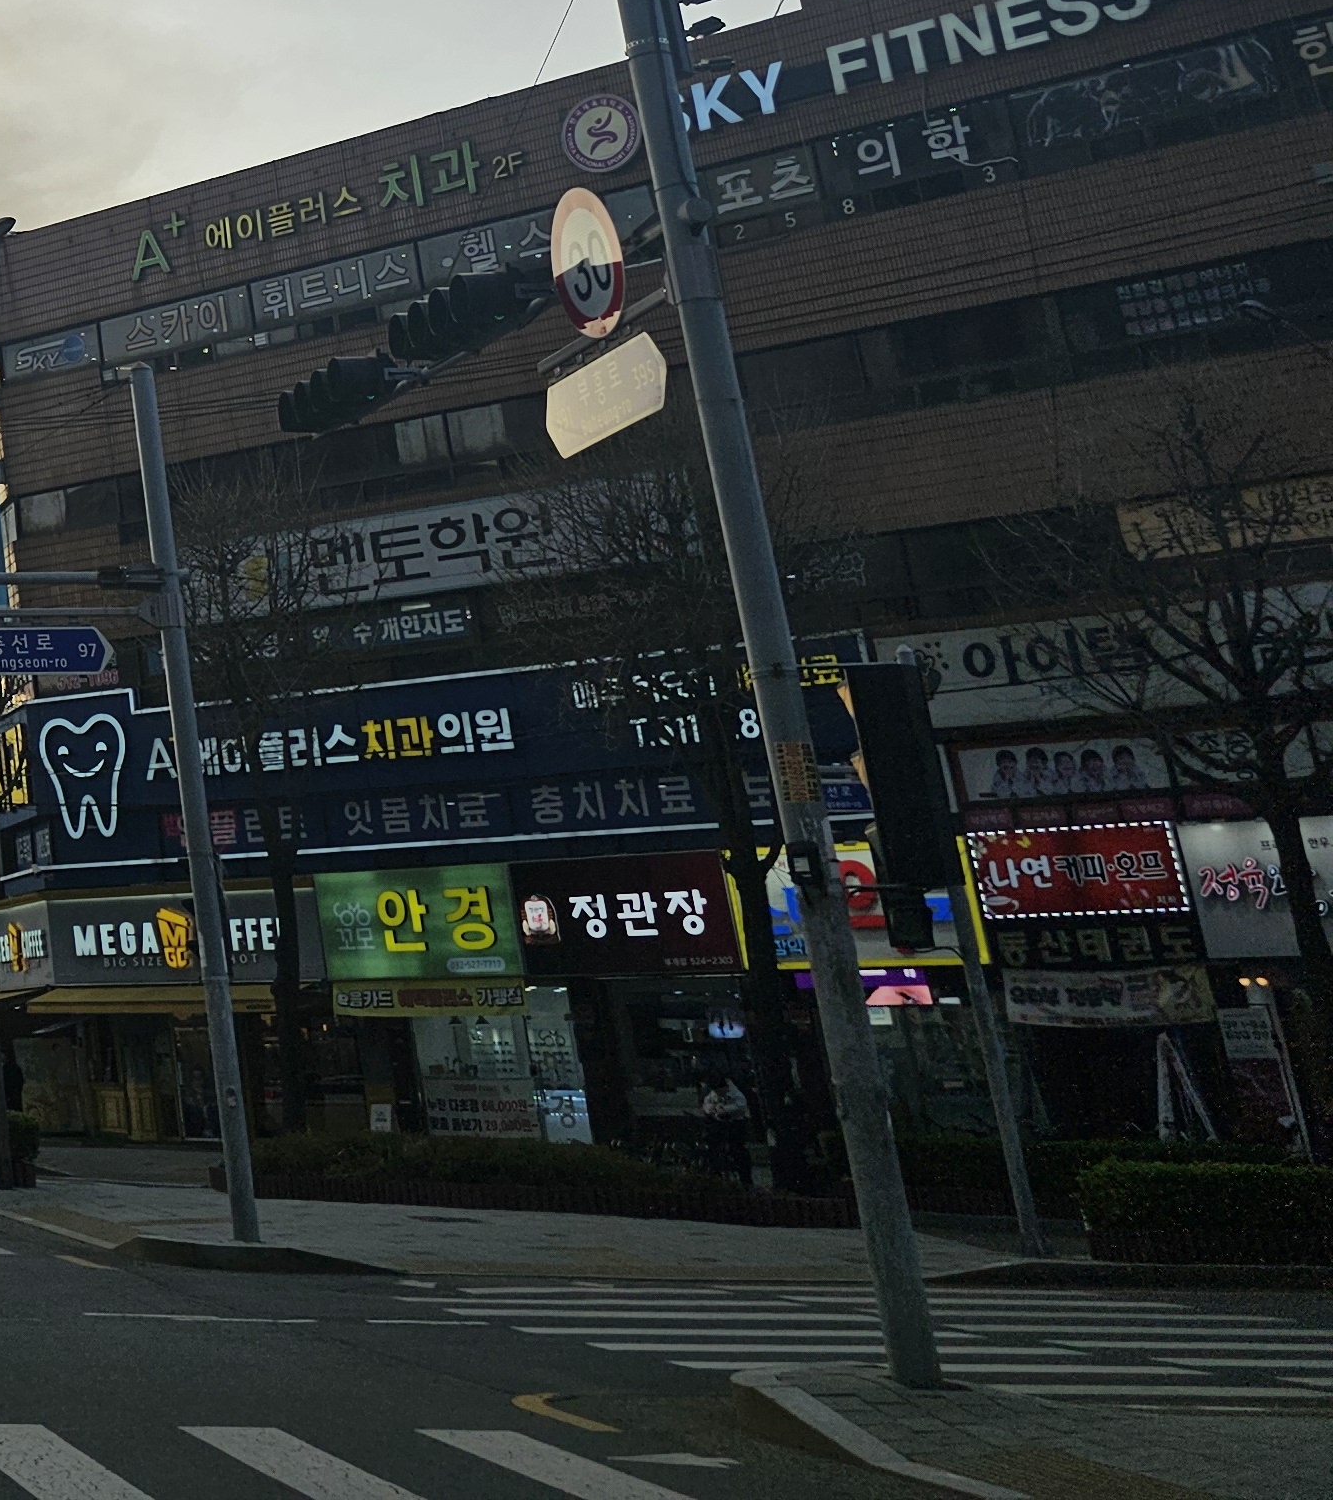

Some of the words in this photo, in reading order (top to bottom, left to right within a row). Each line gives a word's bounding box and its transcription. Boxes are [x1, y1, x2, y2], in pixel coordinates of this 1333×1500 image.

[680, 60, 783, 135] KY
[716, 155, 815, 214] 포츠
[857, 112, 971, 180] 의학
[205, 184, 363, 252] 에이플러스
[378, 140, 483, 210] 치과
[491, 150, 523, 180] 2F
[842, 198, 855, 215] 8
[569, 229, 612, 303] 30
[124, 296, 231, 352] 스카이
[260, 253, 414, 322] 휘트니스
[15, 338, 69, 371] SKY
[631, 358, 656, 390] 395
[577, 361, 623, 407] 부흥로
[310, 506, 558, 595] 멘토학원
[379, 609, 466, 642] 개인지도
[77, 642, 98, 658] 97
[146, 736, 179, 782] A
[342, 793, 491, 838] 잇몸치료
[530, 775, 697, 825] 충치치료
[988, 854, 1054, 889] 나연
[72, 920, 162, 957] MEGA
[228, 916, 280, 952] FFE
[375, 884, 498, 955] 안경
[568, 889, 708, 939] 정관장
[102, 956, 128, 968] BIG
[132, 955, 164, 967] SIZE
[335, 927, 376, 951] 꼬모
[337, 988, 395, 1008] e음카드
[476, 986, 525, 1007] 가맹점
